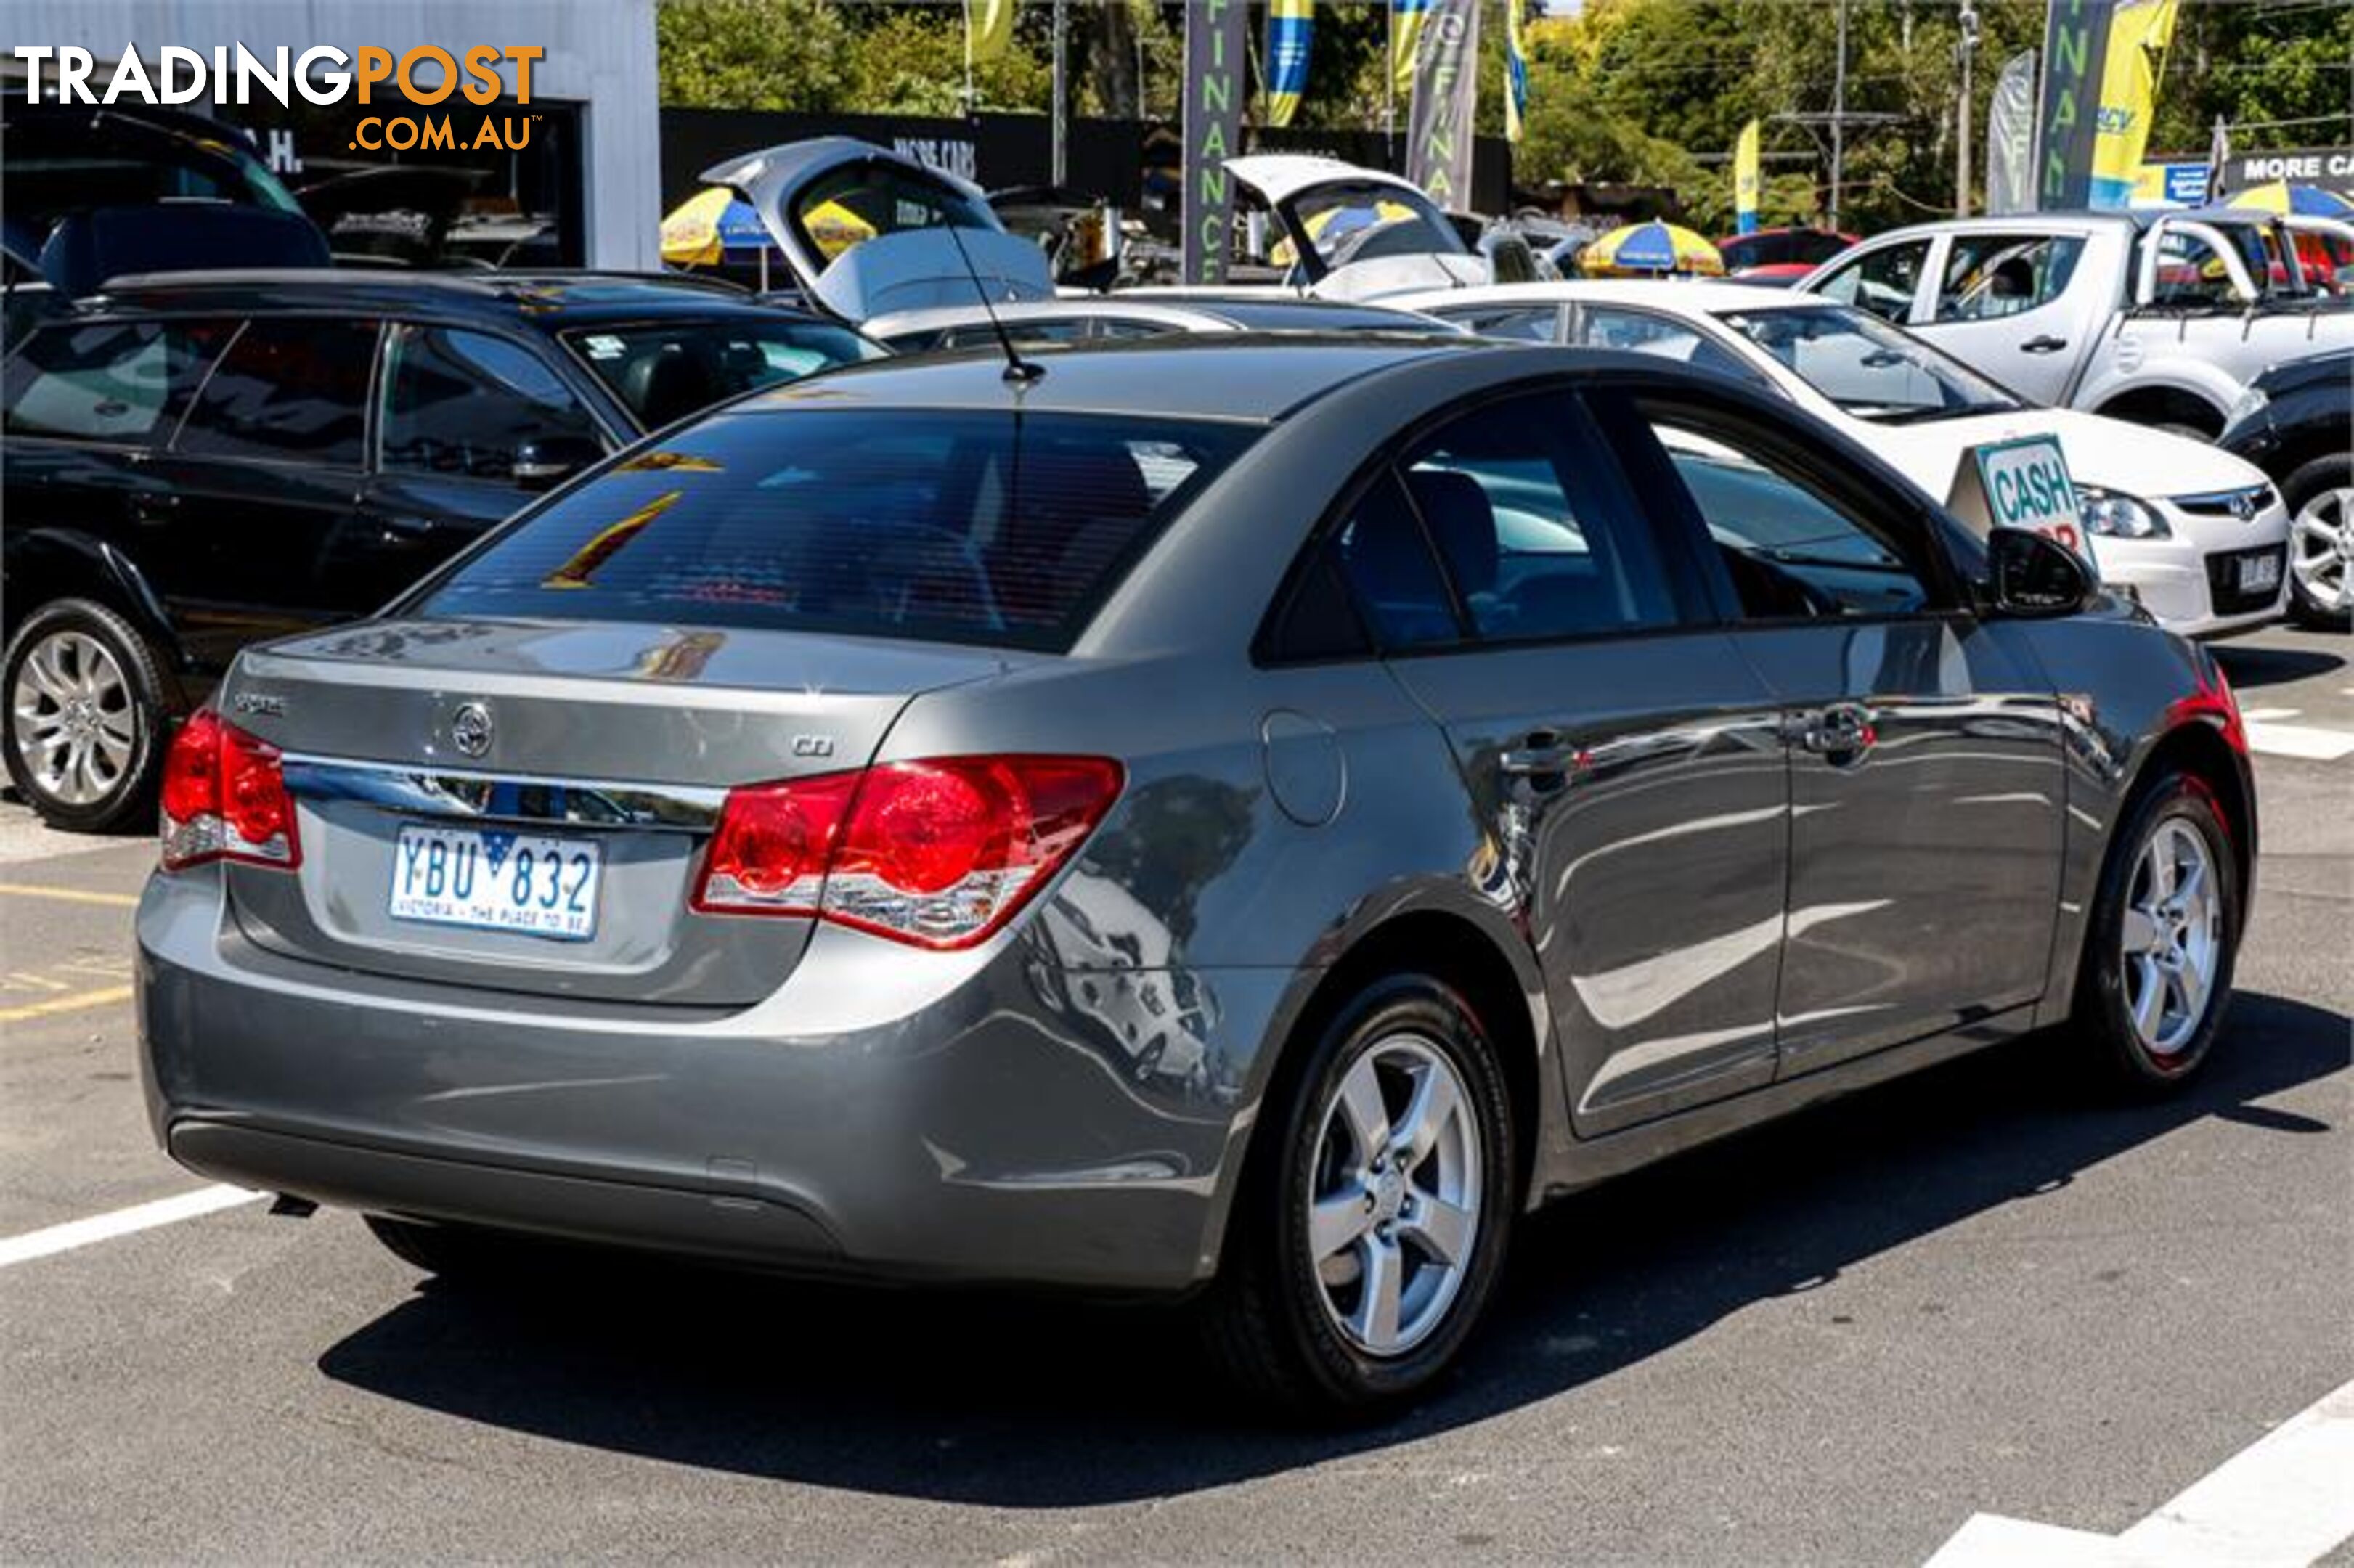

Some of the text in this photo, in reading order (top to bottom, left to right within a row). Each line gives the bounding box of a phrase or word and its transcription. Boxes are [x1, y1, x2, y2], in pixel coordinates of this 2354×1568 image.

[2244, 155, 2321, 180] MORE
[1996, 460, 2072, 522] CASH
[403, 836, 591, 913] YBU 832
